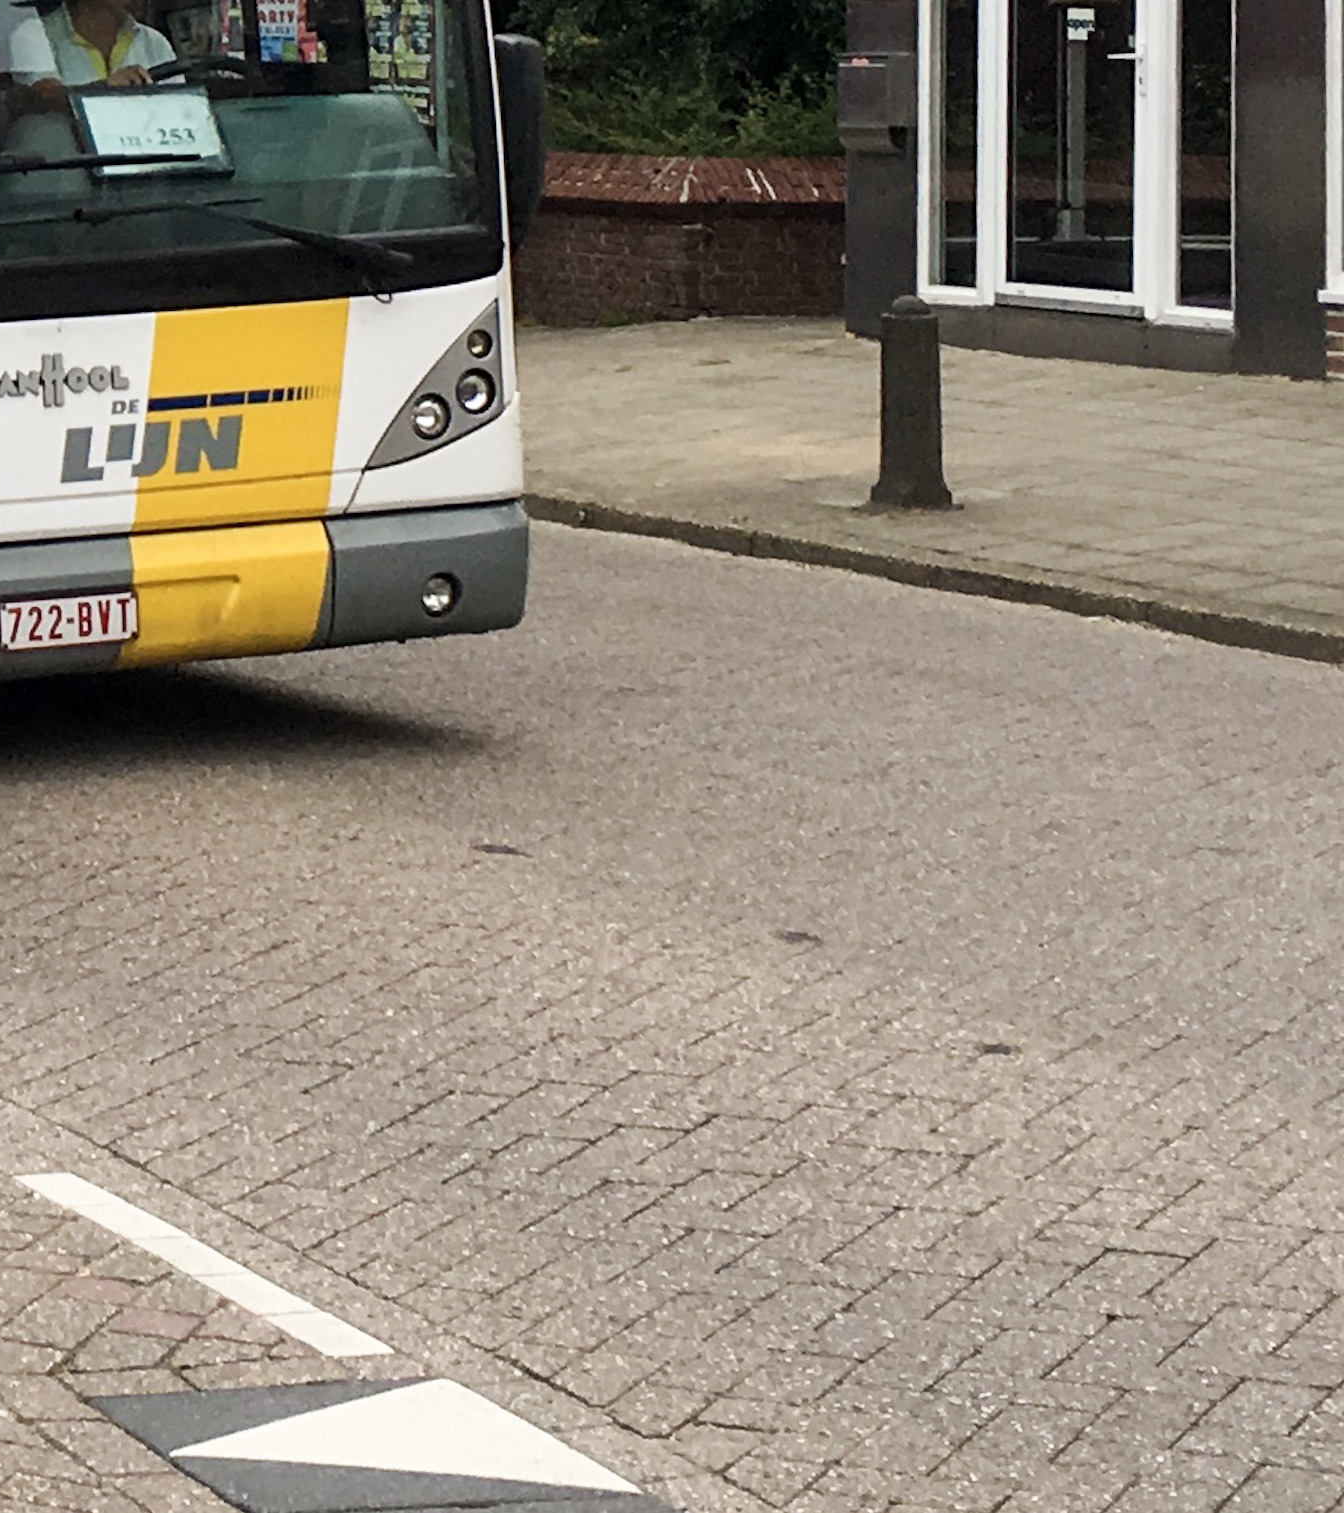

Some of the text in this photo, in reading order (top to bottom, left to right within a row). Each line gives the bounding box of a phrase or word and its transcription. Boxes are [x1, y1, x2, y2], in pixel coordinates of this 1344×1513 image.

[156, 127, 196, 145] 253
[112, 399, 140, 415] DE
[60, 414, 244, 484] LIJN
[7, 597, 131, 643] 722-BVT
